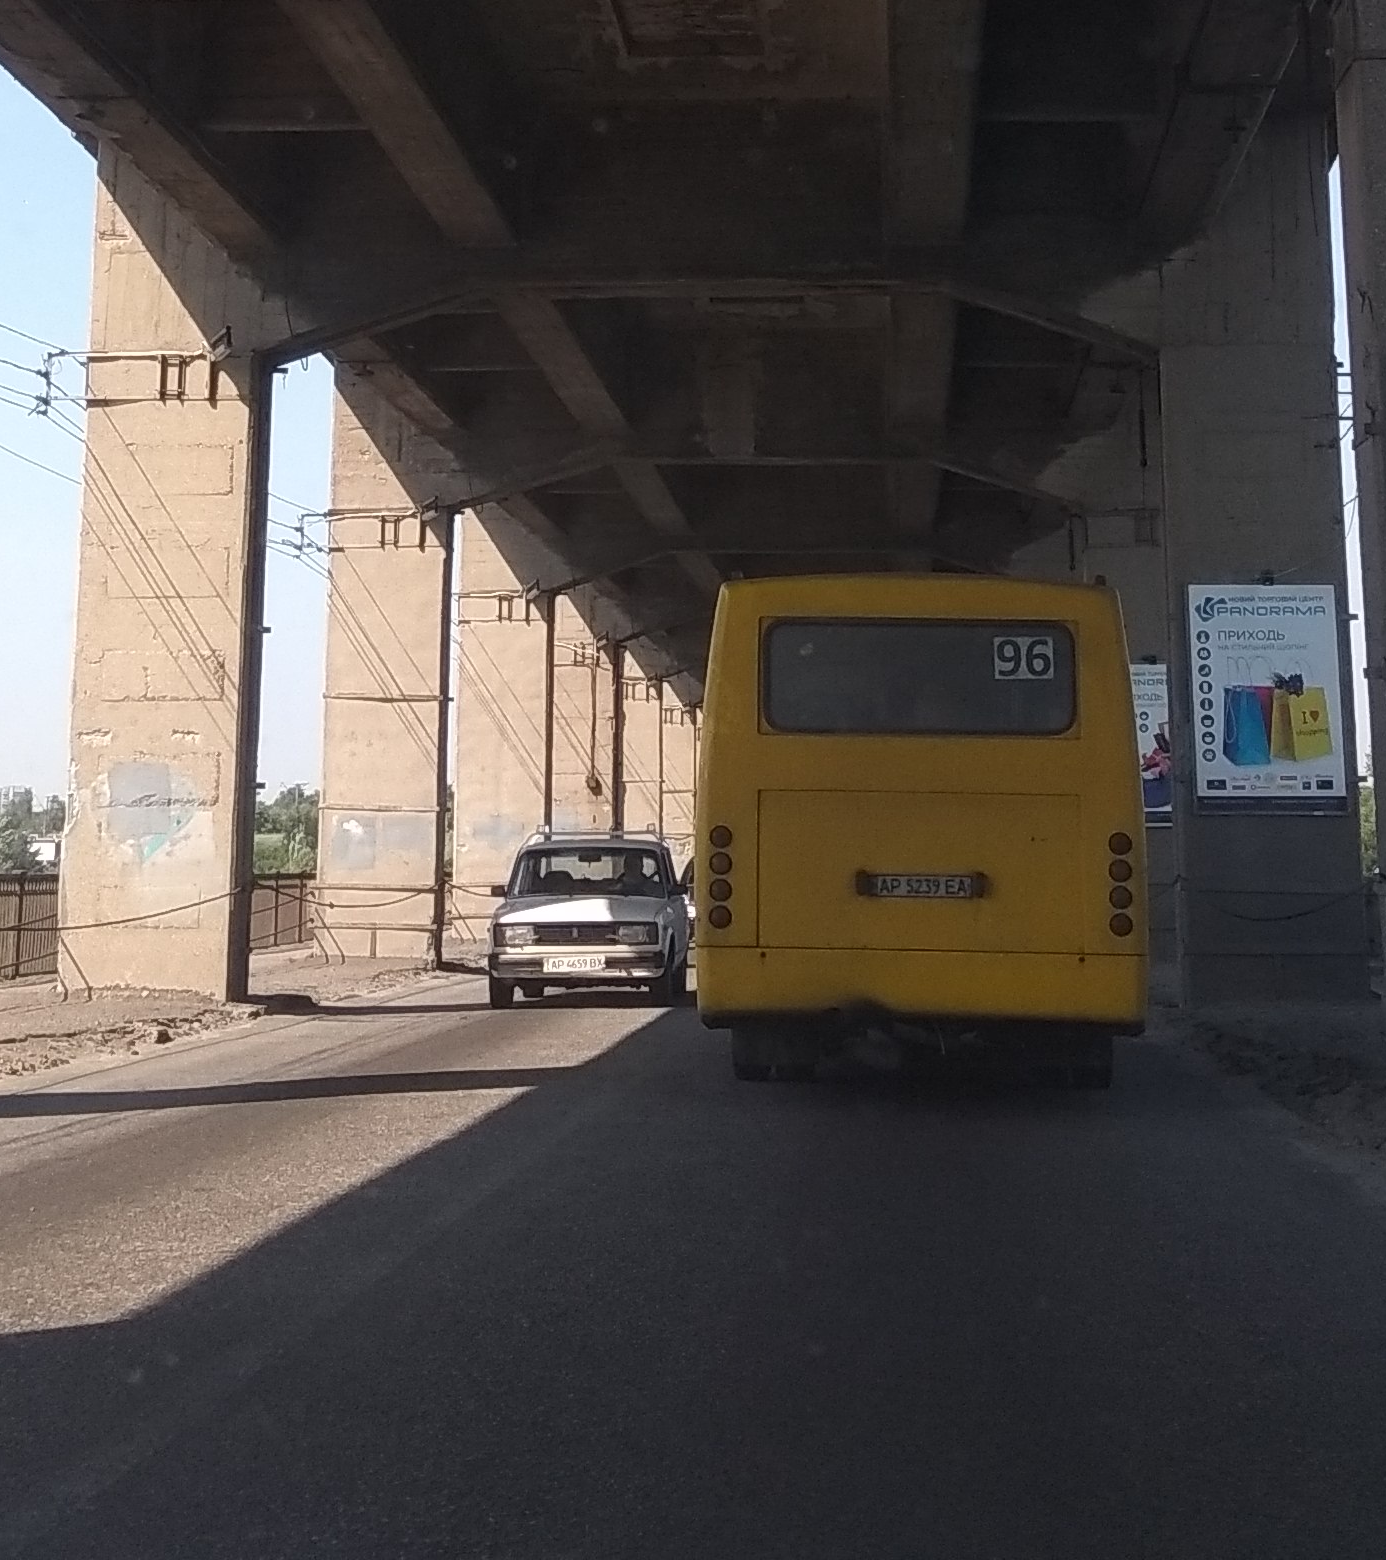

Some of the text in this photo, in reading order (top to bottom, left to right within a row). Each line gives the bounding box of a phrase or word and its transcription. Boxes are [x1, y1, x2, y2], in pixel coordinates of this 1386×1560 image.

[1216, 605, 1326, 617] PANORAMA
[1217, 629, 1286, 642] ПРИХОДЬ
[997, 639, 1051, 676] 96
[879, 878, 967, 895] AP 5239 EA
[551, 956, 603, 969] AP 4659 BX
